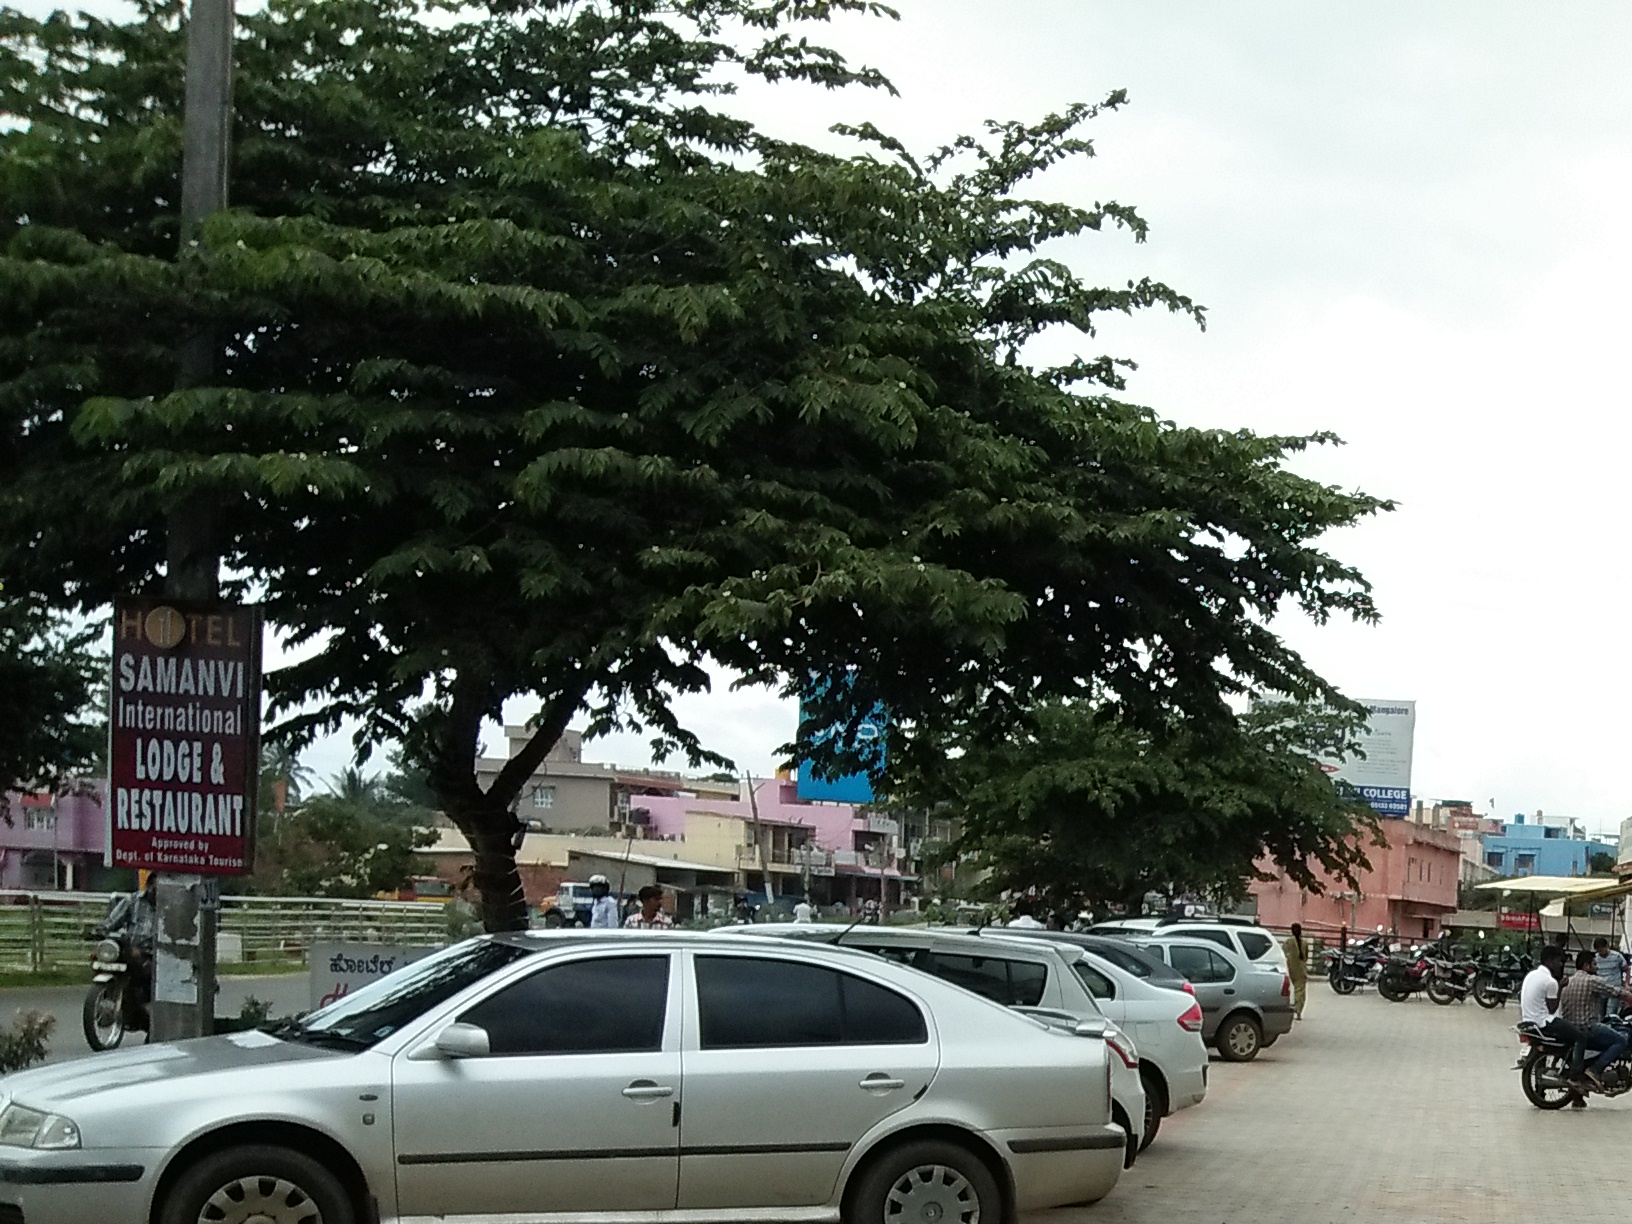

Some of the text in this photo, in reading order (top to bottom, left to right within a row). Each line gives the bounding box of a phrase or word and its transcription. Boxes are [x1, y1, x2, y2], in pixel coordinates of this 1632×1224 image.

[120, 606, 241, 649] HOTEL
[119, 652, 244, 698] SAMANVI
[118, 697, 242, 735] International
[1370, 705, 1409, 715] Mangalore
[136, 737, 225, 785] LODGE &
[117, 787, 243, 836] RESTAURANT
[1363, 788, 1407, 799] COLLEGE
[152, 836, 209, 853] Approved by
